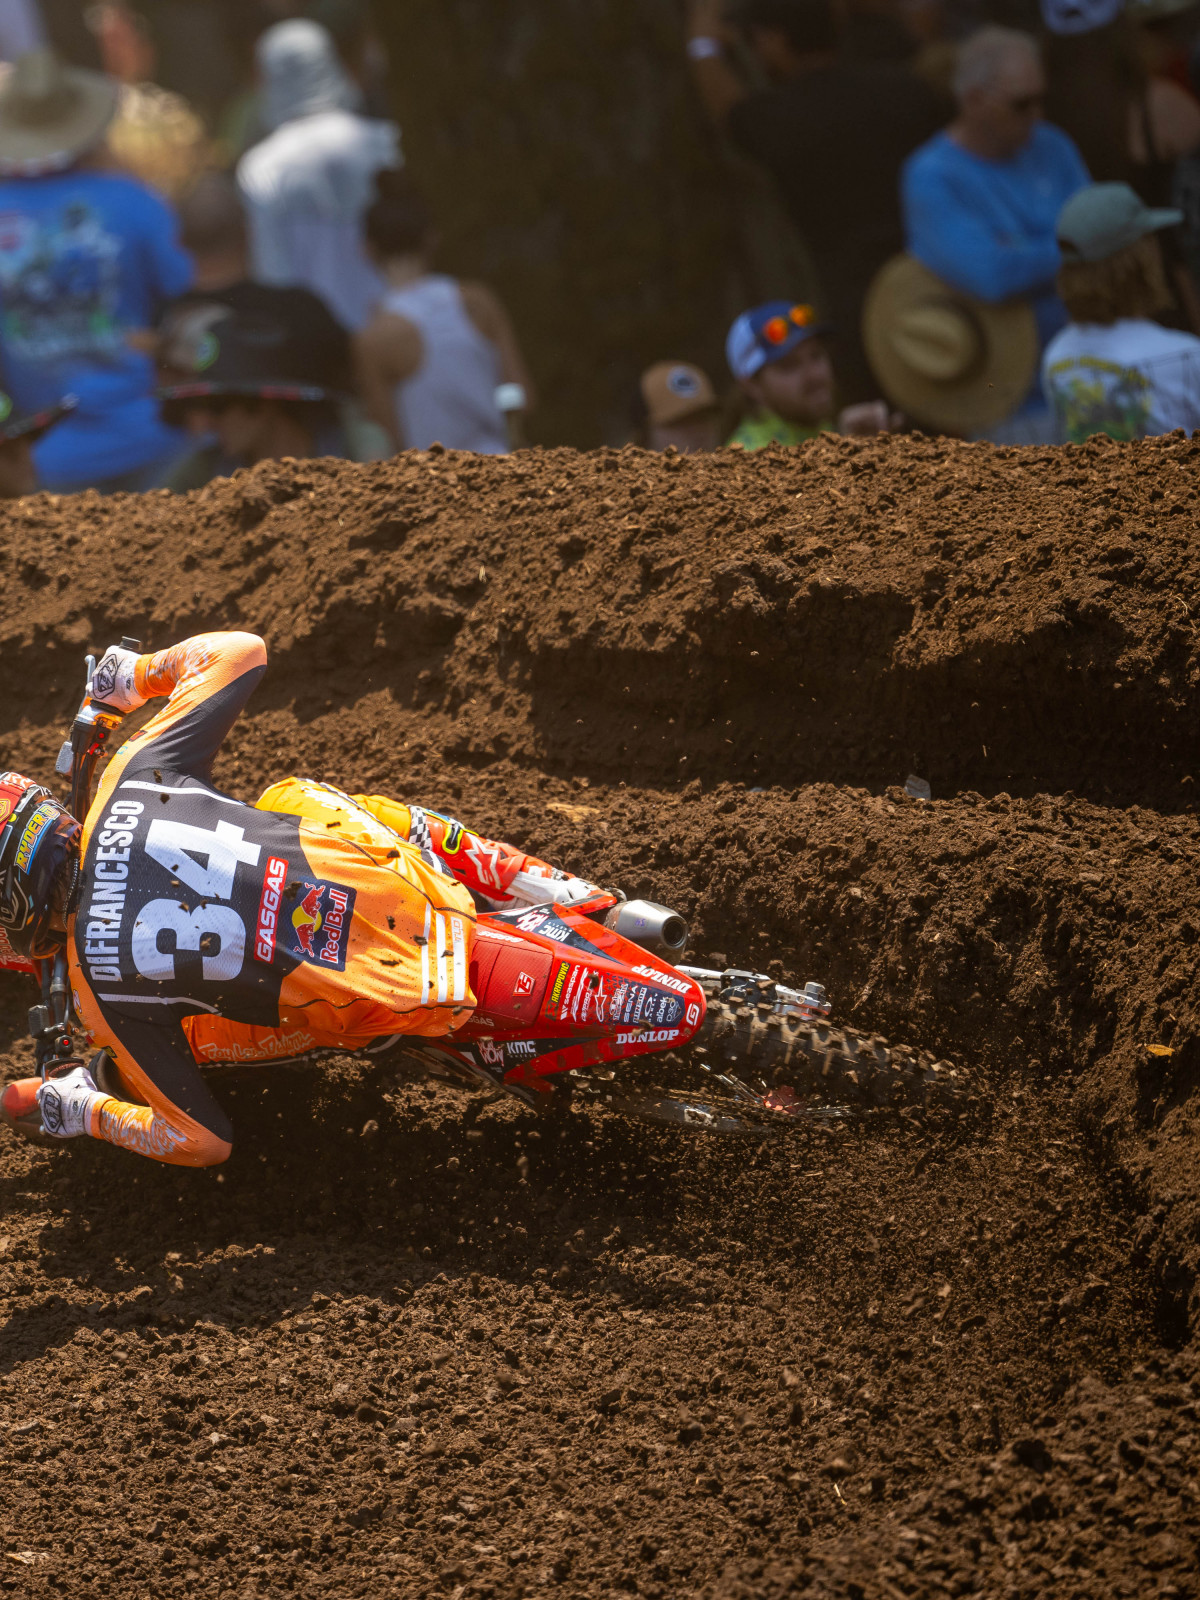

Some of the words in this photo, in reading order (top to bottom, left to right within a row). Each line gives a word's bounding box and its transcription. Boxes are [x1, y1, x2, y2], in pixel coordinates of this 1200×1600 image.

[15, 814, 48, 871] RYDER
[85, 800, 145, 982] DIFRANCESCO
[132, 819, 261, 981] 34
[257, 859, 286, 962] GASGAS
[325, 888, 349, 929] Bull
[320, 925, 342, 964] Red
[564, 964, 580, 1004] seaspan
[631, 964, 693, 994] DUNLOP
[623, 985, 638, 1023] SENA
[506, 1040, 537, 1055] KMC
[616, 1029, 680, 1045] DUNLOP
